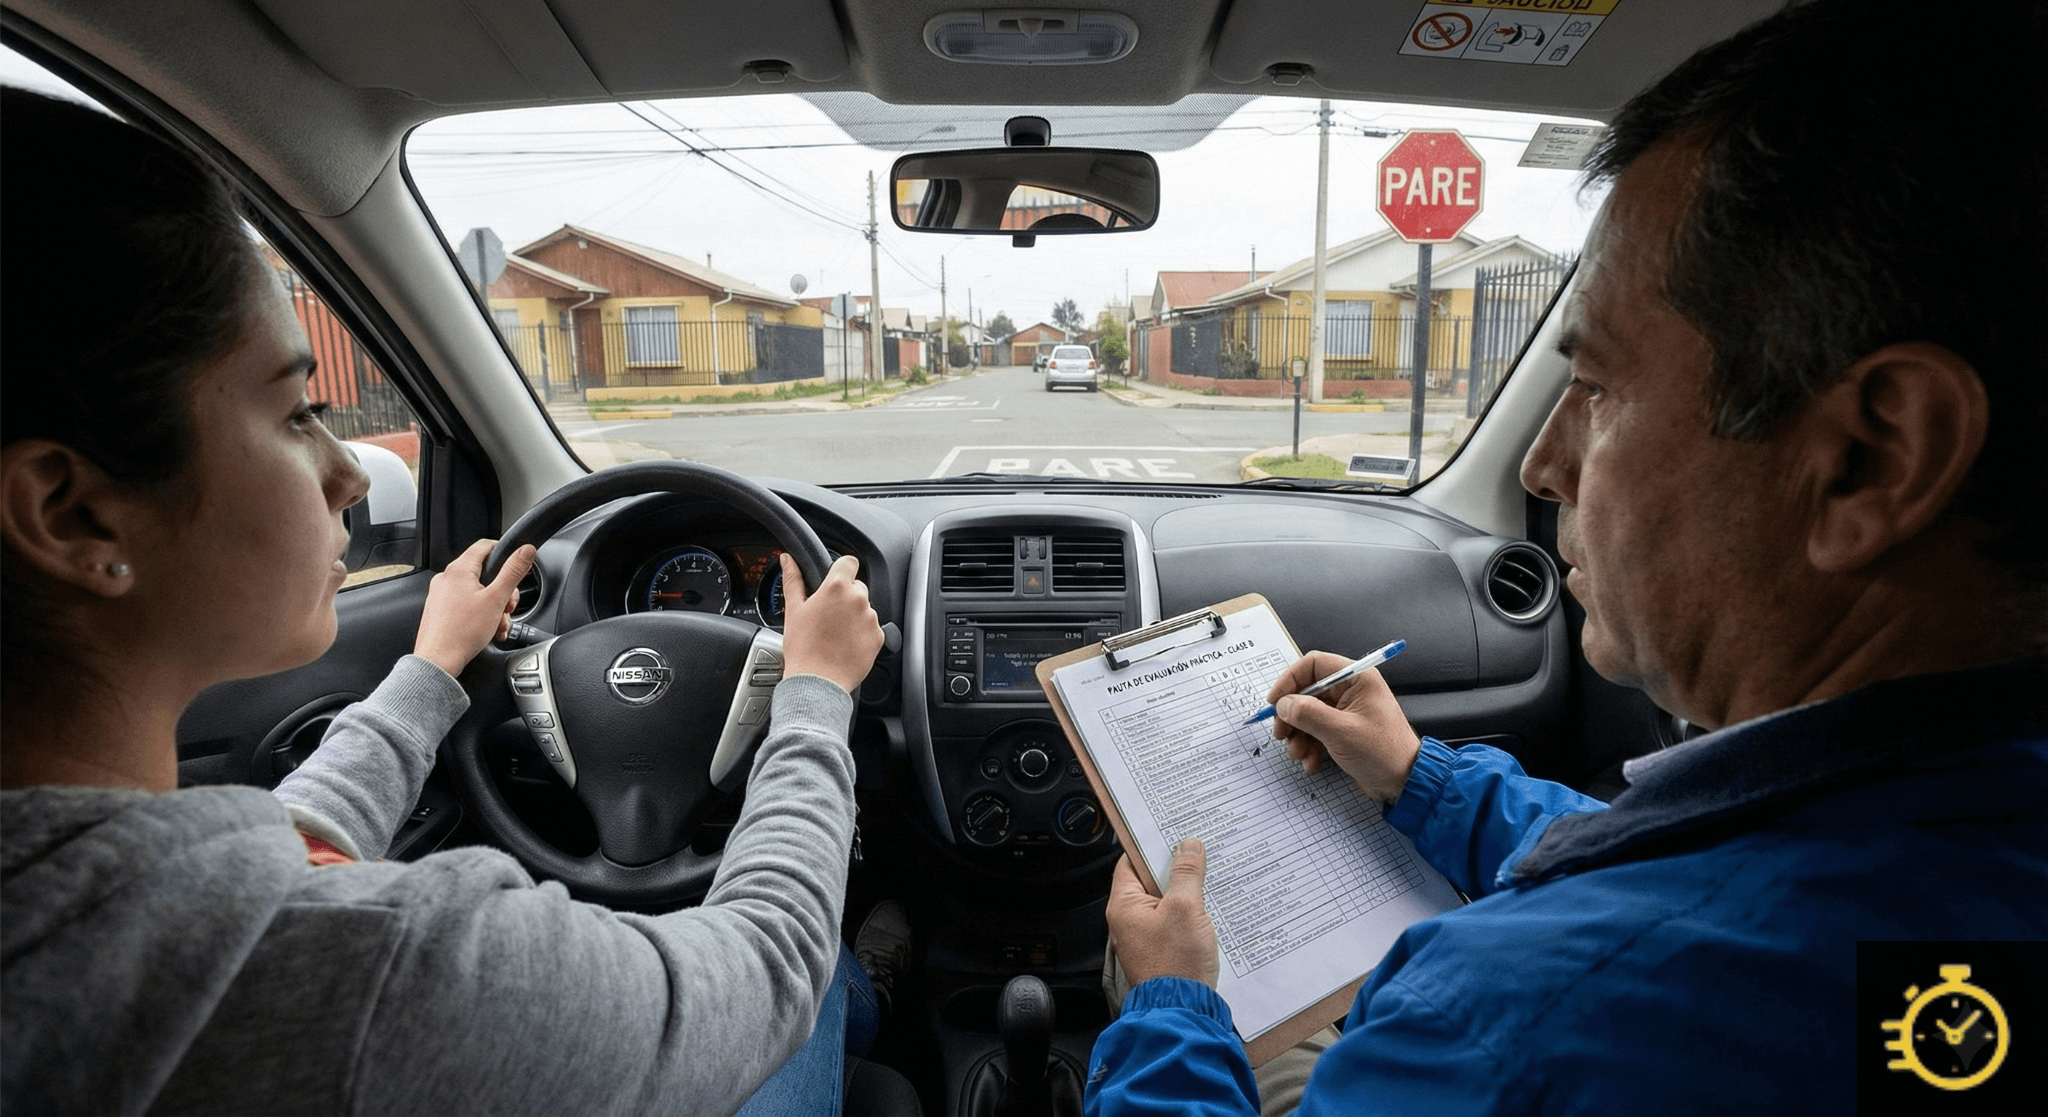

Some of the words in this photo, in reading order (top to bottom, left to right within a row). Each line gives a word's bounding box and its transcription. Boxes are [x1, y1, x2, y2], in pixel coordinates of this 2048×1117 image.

[1385, 167, 1477, 206] PARE
[984, 457, 1196, 479] PARE
[612, 670, 662, 681] NISSAN
[1107, 680, 1133, 695] PAUTA
[1133, 676, 1144, 687] DE
[1227, 641, 1248, 654] CLASE
